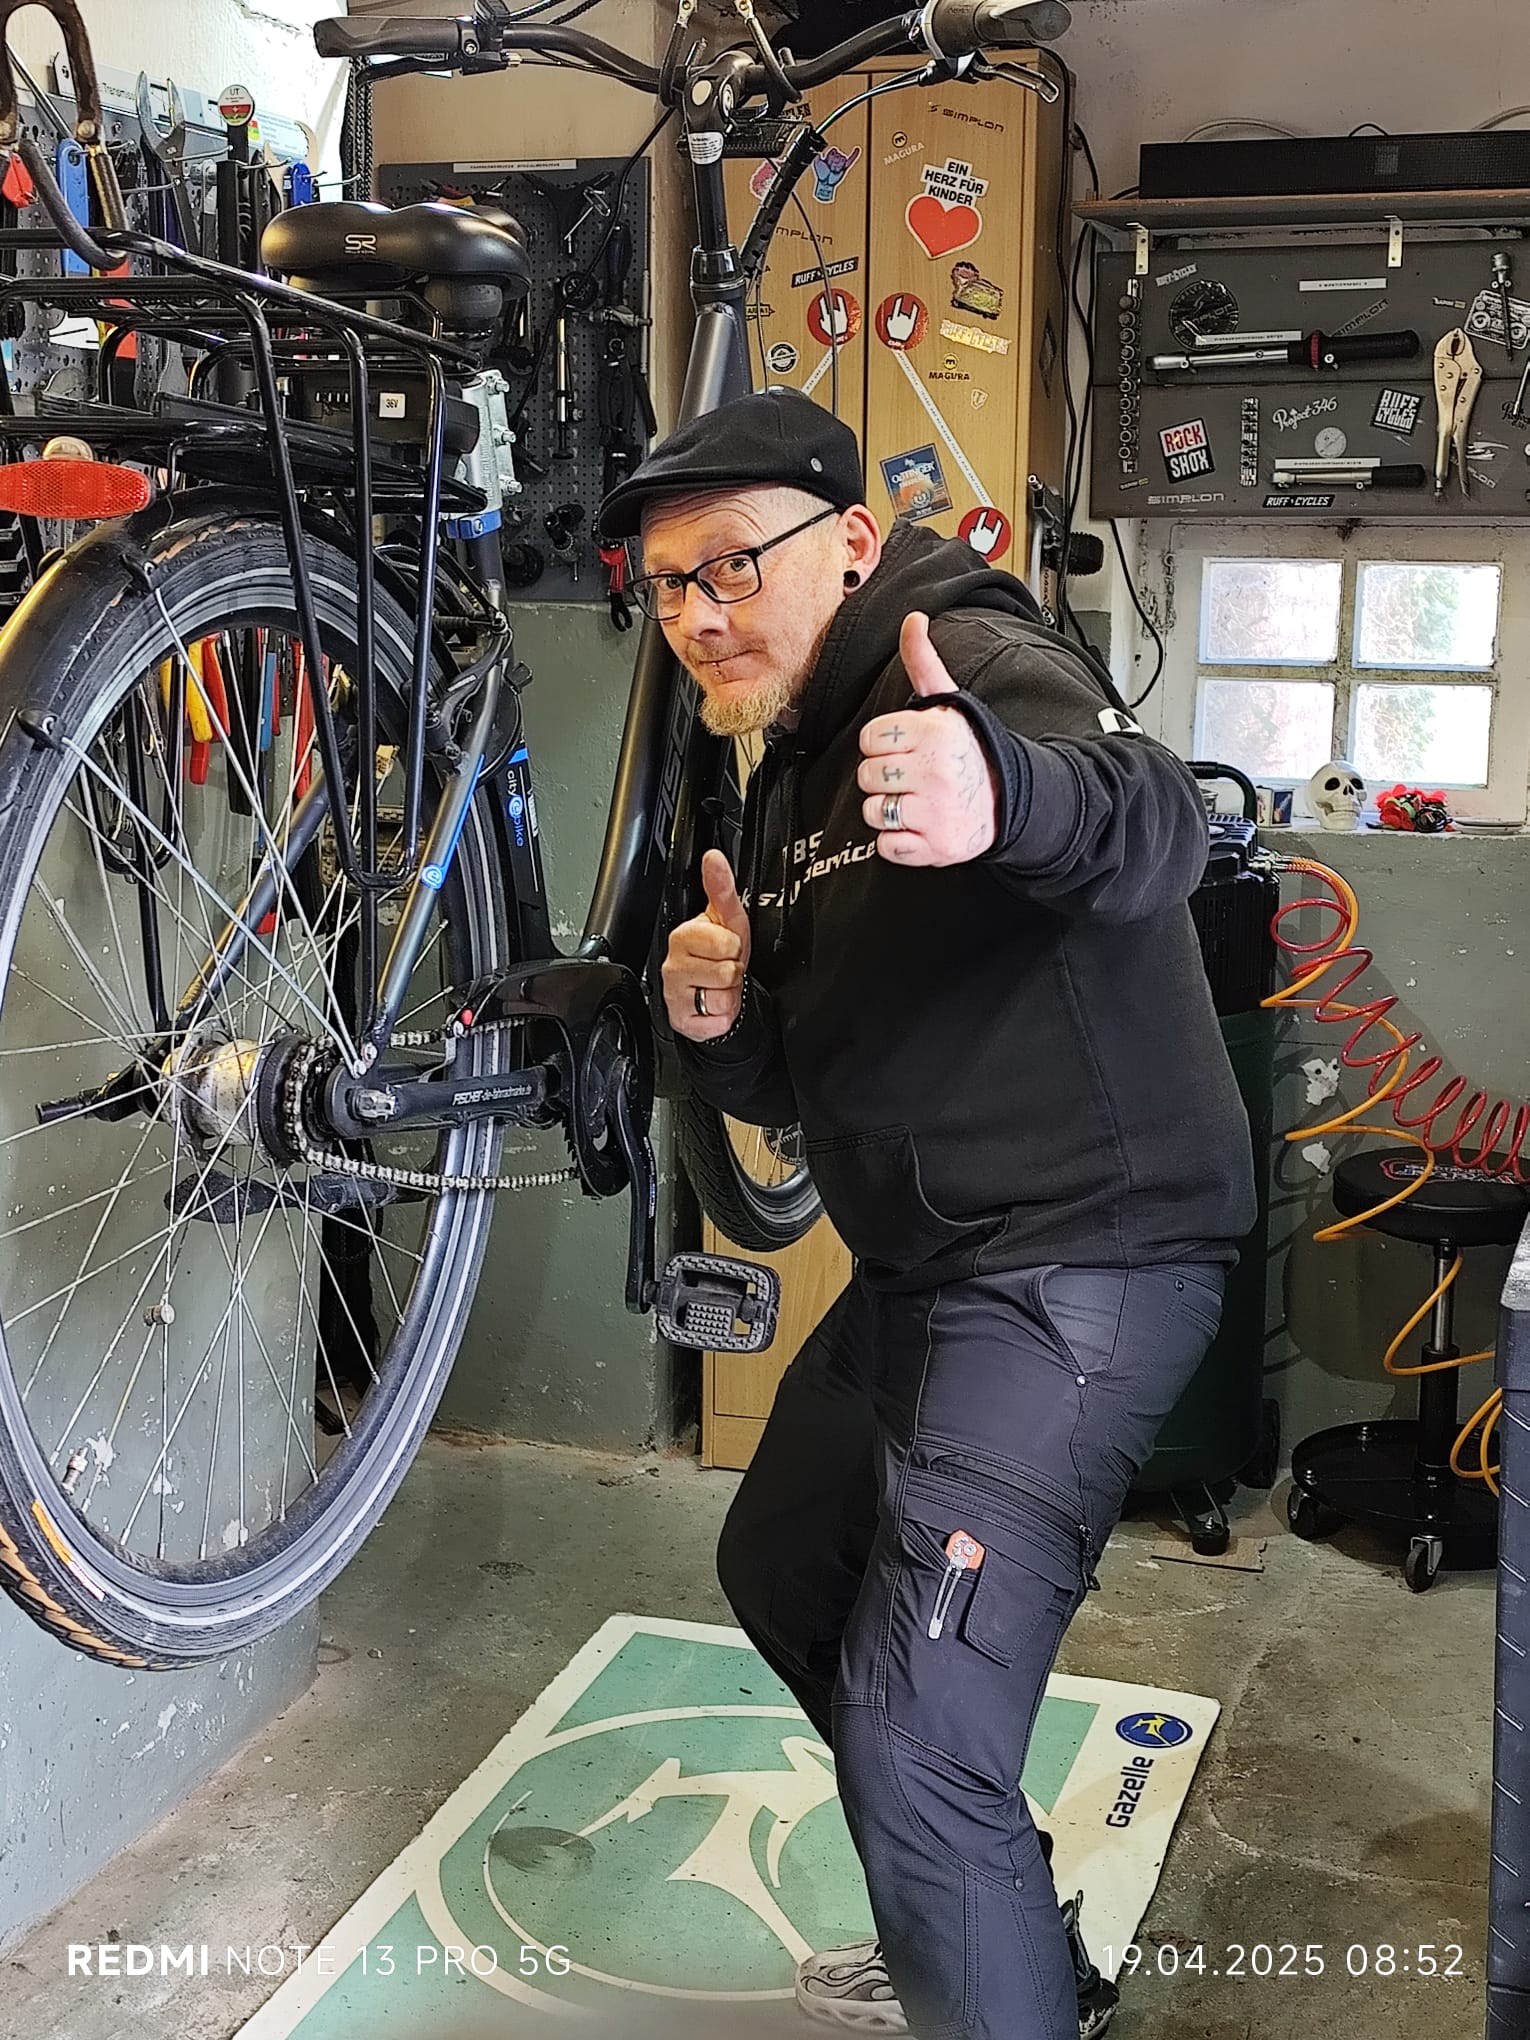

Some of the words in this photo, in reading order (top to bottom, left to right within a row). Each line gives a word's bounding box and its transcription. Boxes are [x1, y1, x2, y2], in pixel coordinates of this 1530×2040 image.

[942, 108, 1005, 132] SIMPLON
[884, 142, 925, 165] MAGURA
[947, 161, 969, 176] EIN
[924, 170, 957, 188] HERZ
[958, 177, 985, 195] FÜR
[927, 184, 974, 206] KINDER
[775, 226, 833, 246] MPLON
[794, 270, 817, 286] RUFF
[823, 260, 856, 278] YCLES
[928, 371, 970, 381] MAGURA
[1272, 404, 1312, 432] Project
[1312, 396, 1338, 416] 346
[1163, 424, 1204, 453] ROCK
[1169, 448, 1210, 479] SHOX
[1147, 492, 1225, 505] SIMPLON
[1265, 496, 1290, 506] RUFF
[1293, 496, 1331, 506] CYCLES
[1105, 1755, 1155, 1829] Gazelle
